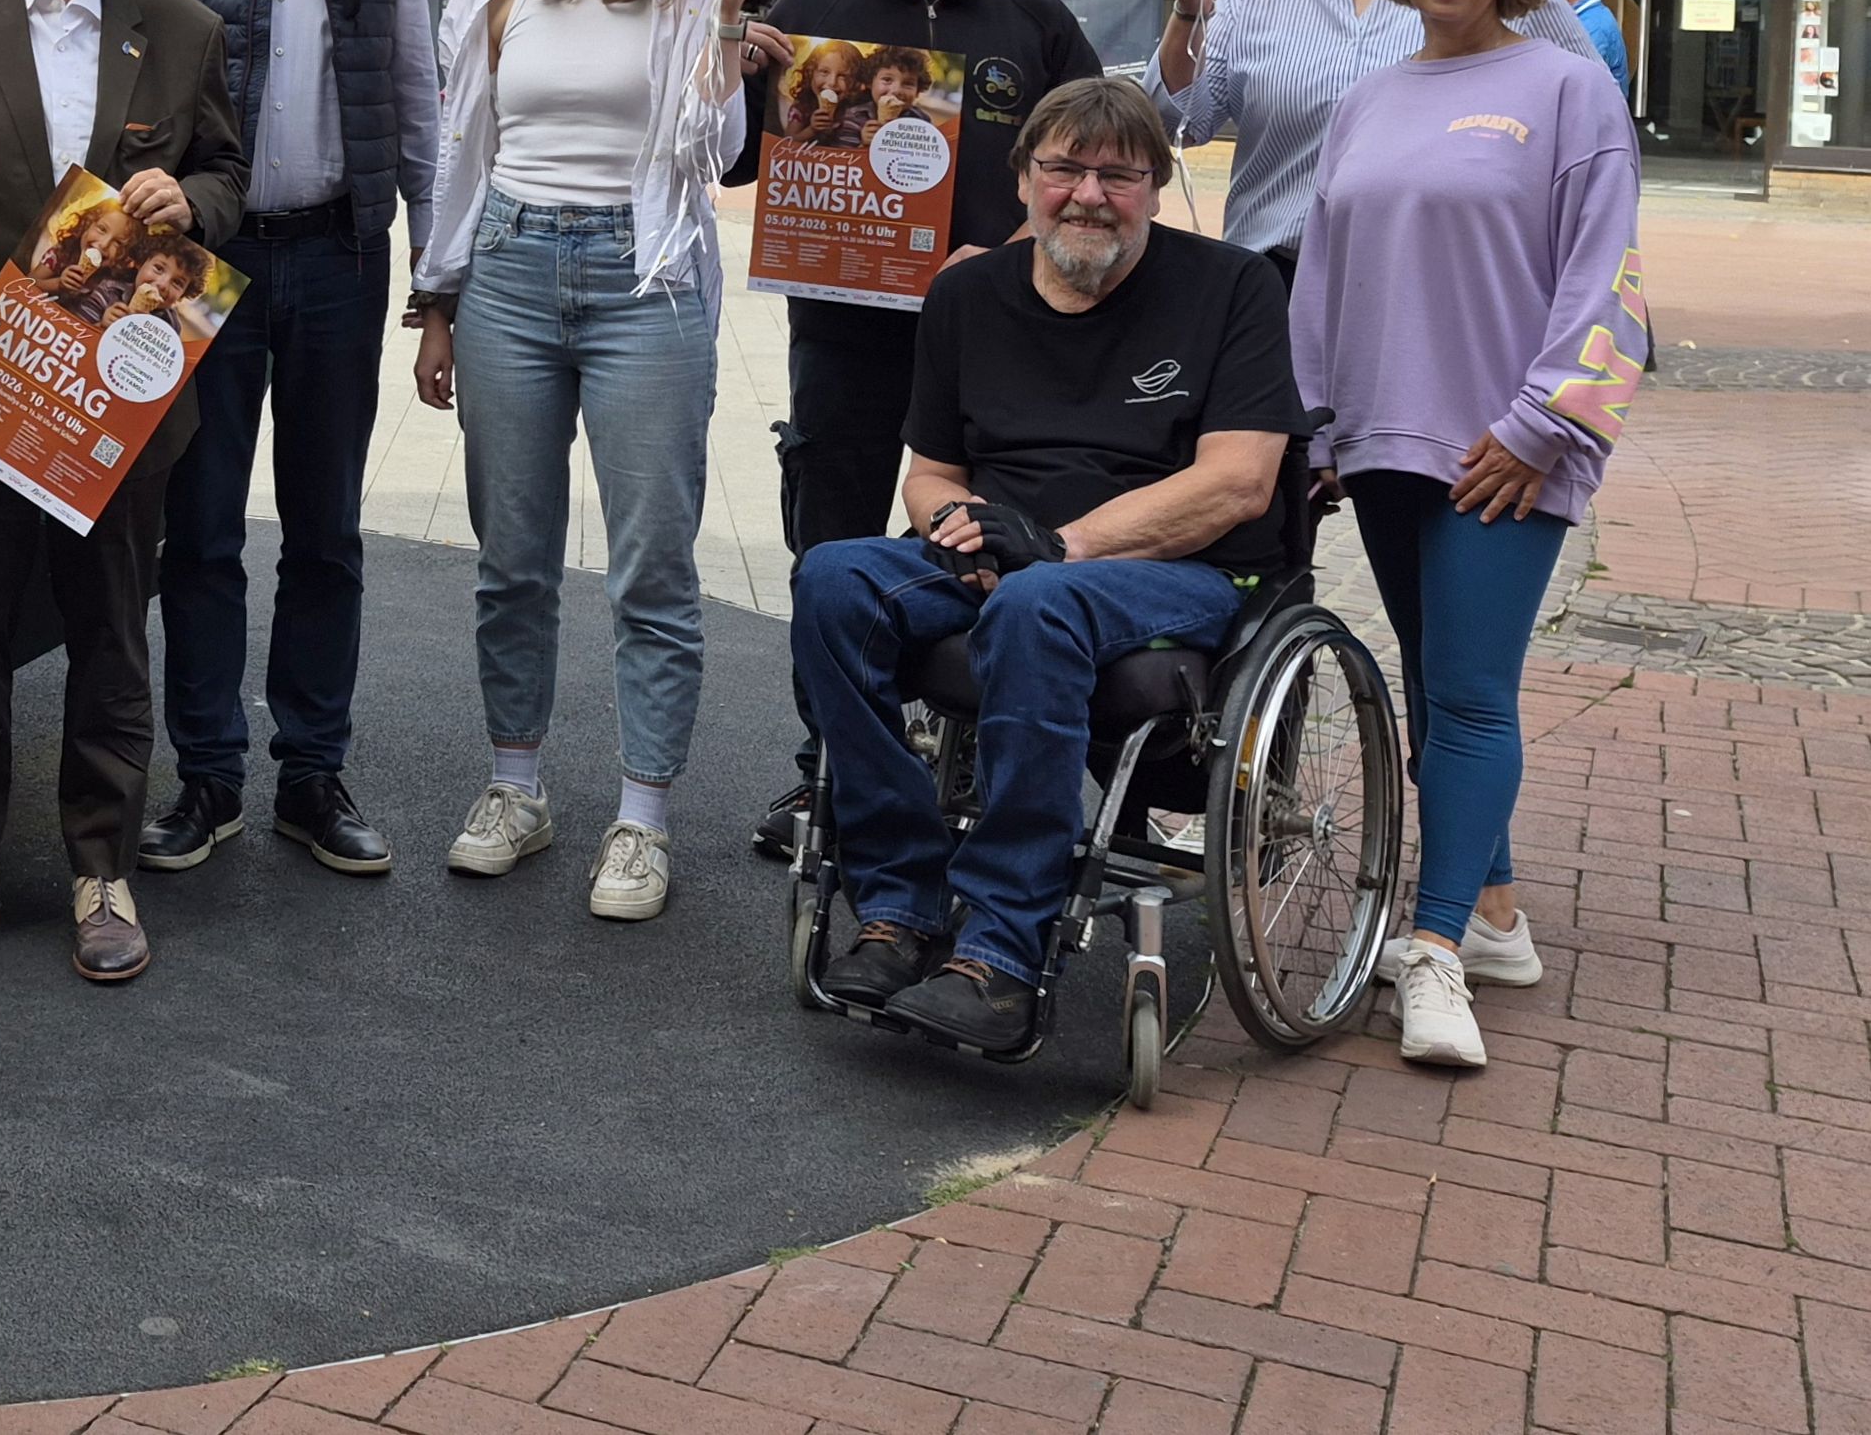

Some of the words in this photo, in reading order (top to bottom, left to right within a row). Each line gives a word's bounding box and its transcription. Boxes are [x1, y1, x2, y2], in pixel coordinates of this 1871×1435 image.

[769, 159, 863, 188] KINDER
[766, 182, 904, 219] SAMSTAG
[765, 214, 827, 230] 05.09.2026
[836, 221, 850, 233] 10
[860, 224, 874, 235] 16
[876, 226, 897, 238] Uhr
[127, 321, 171, 354] PROGRAMM
[144, 320, 171, 343] BUNTES
[29, 392, 44, 407] 10
[51, 406, 66, 422] 16
[66, 416, 87, 436] Uhr
